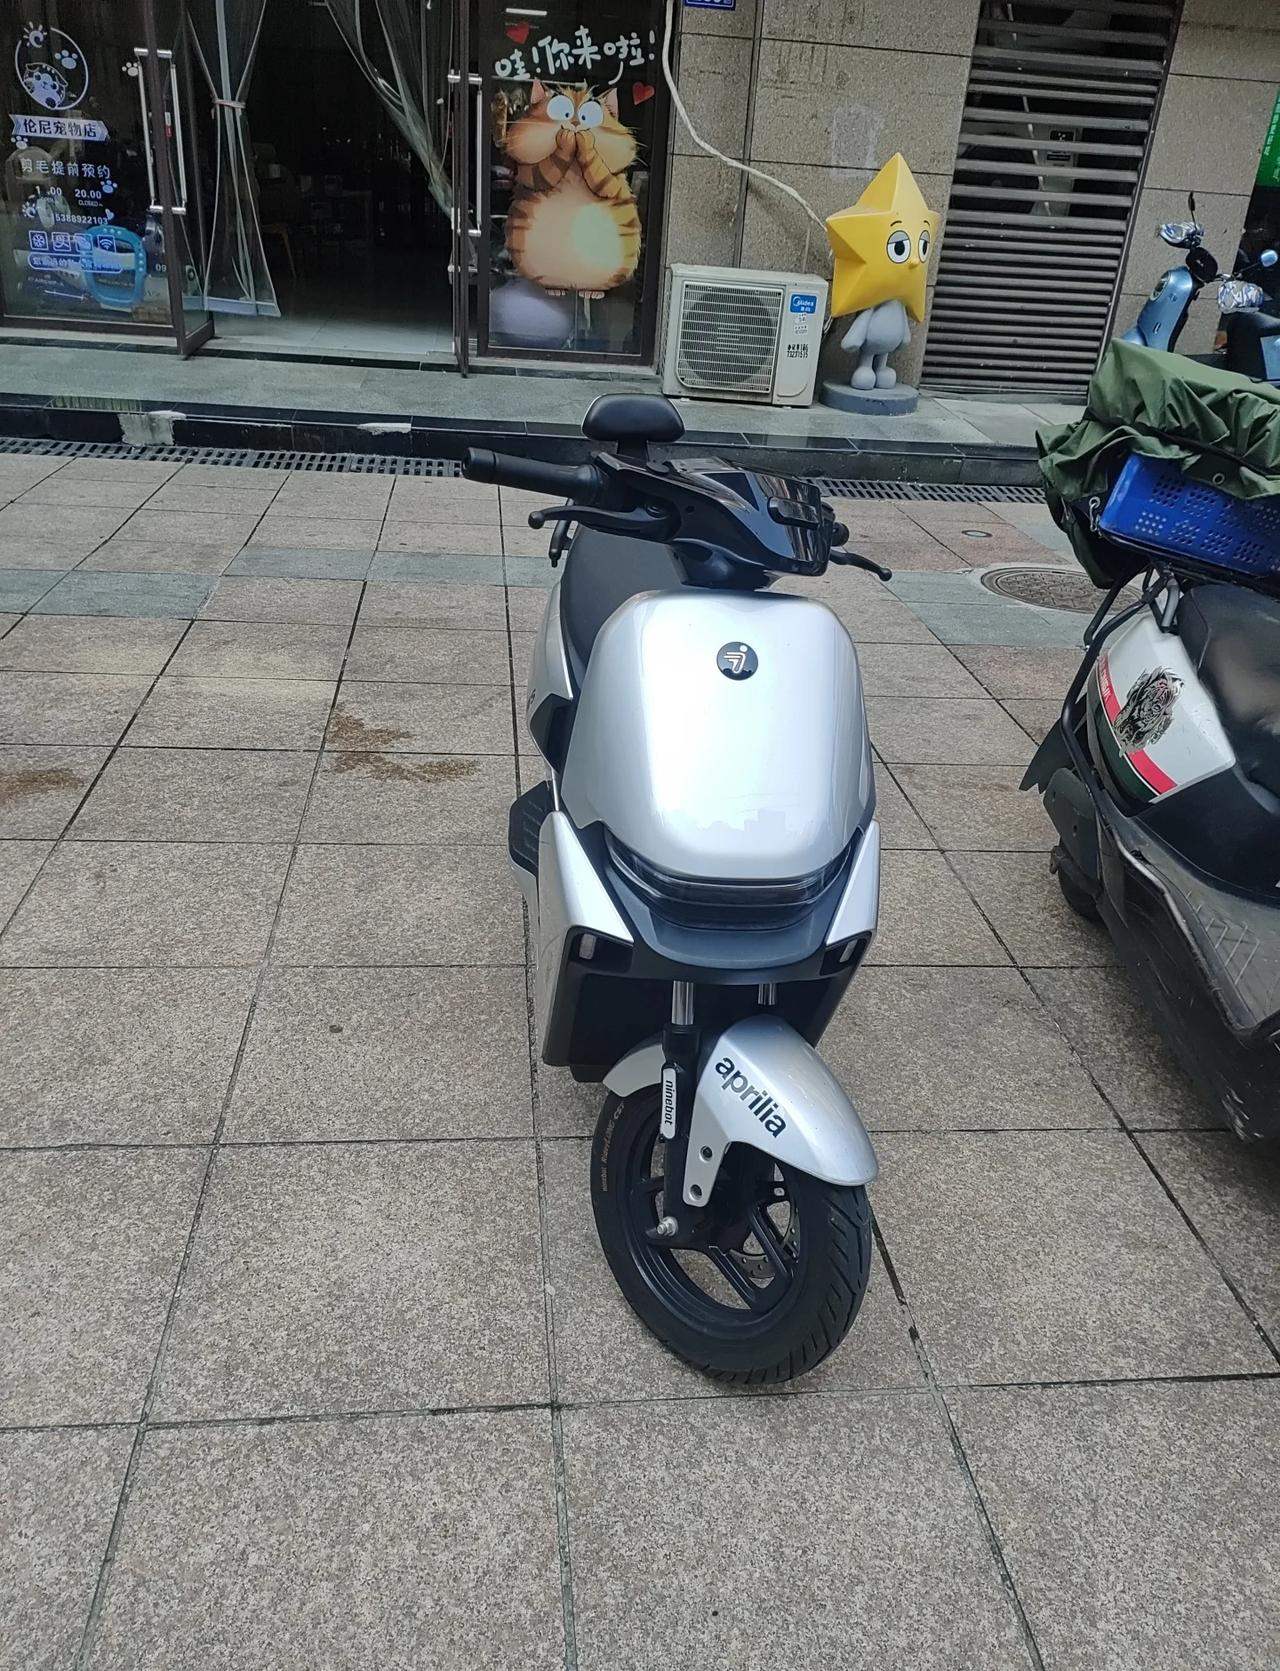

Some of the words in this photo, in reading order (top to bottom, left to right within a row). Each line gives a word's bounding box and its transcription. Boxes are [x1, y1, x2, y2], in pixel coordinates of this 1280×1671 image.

[24, 118, 97, 138] 伦尼宠物店
[75, 188, 102, 199] 20.00
[664, 1079, 675, 1126] ninebot
[715, 1056, 788, 1139] aprilia
